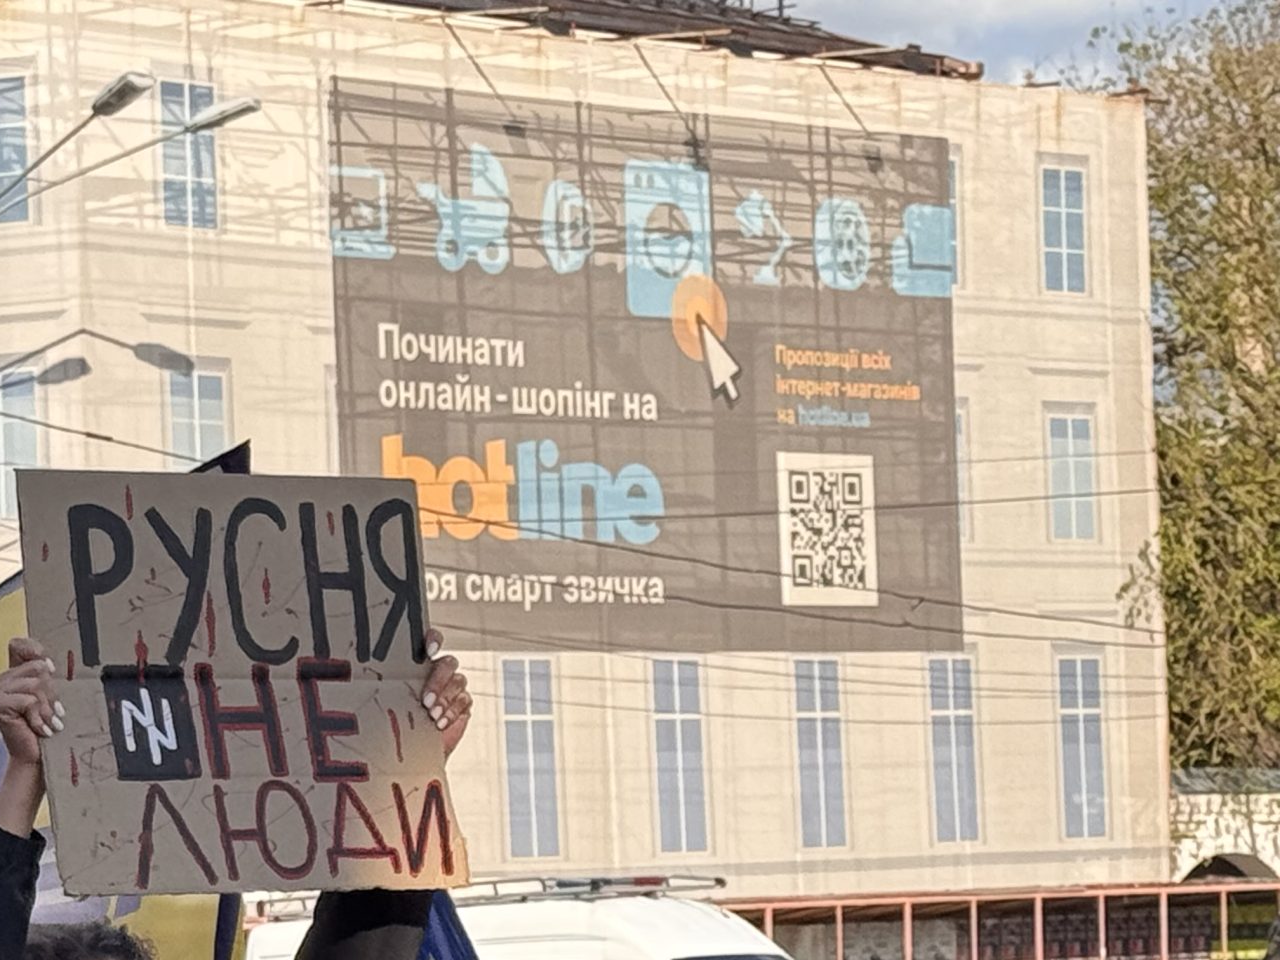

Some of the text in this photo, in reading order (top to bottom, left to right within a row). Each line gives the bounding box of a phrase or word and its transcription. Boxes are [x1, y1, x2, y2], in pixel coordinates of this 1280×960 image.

[377, 322, 526, 367] Починати
[623, 392, 658, 421] на
[382, 433, 665, 545] hotline
[67, 497, 427, 667] РУСНЯ
[466, 573, 557, 611] смарт
[564, 575, 665, 604] звичка
[195, 657, 369, 782] НЕ
[136, 779, 455, 889] ЛЮДИ
